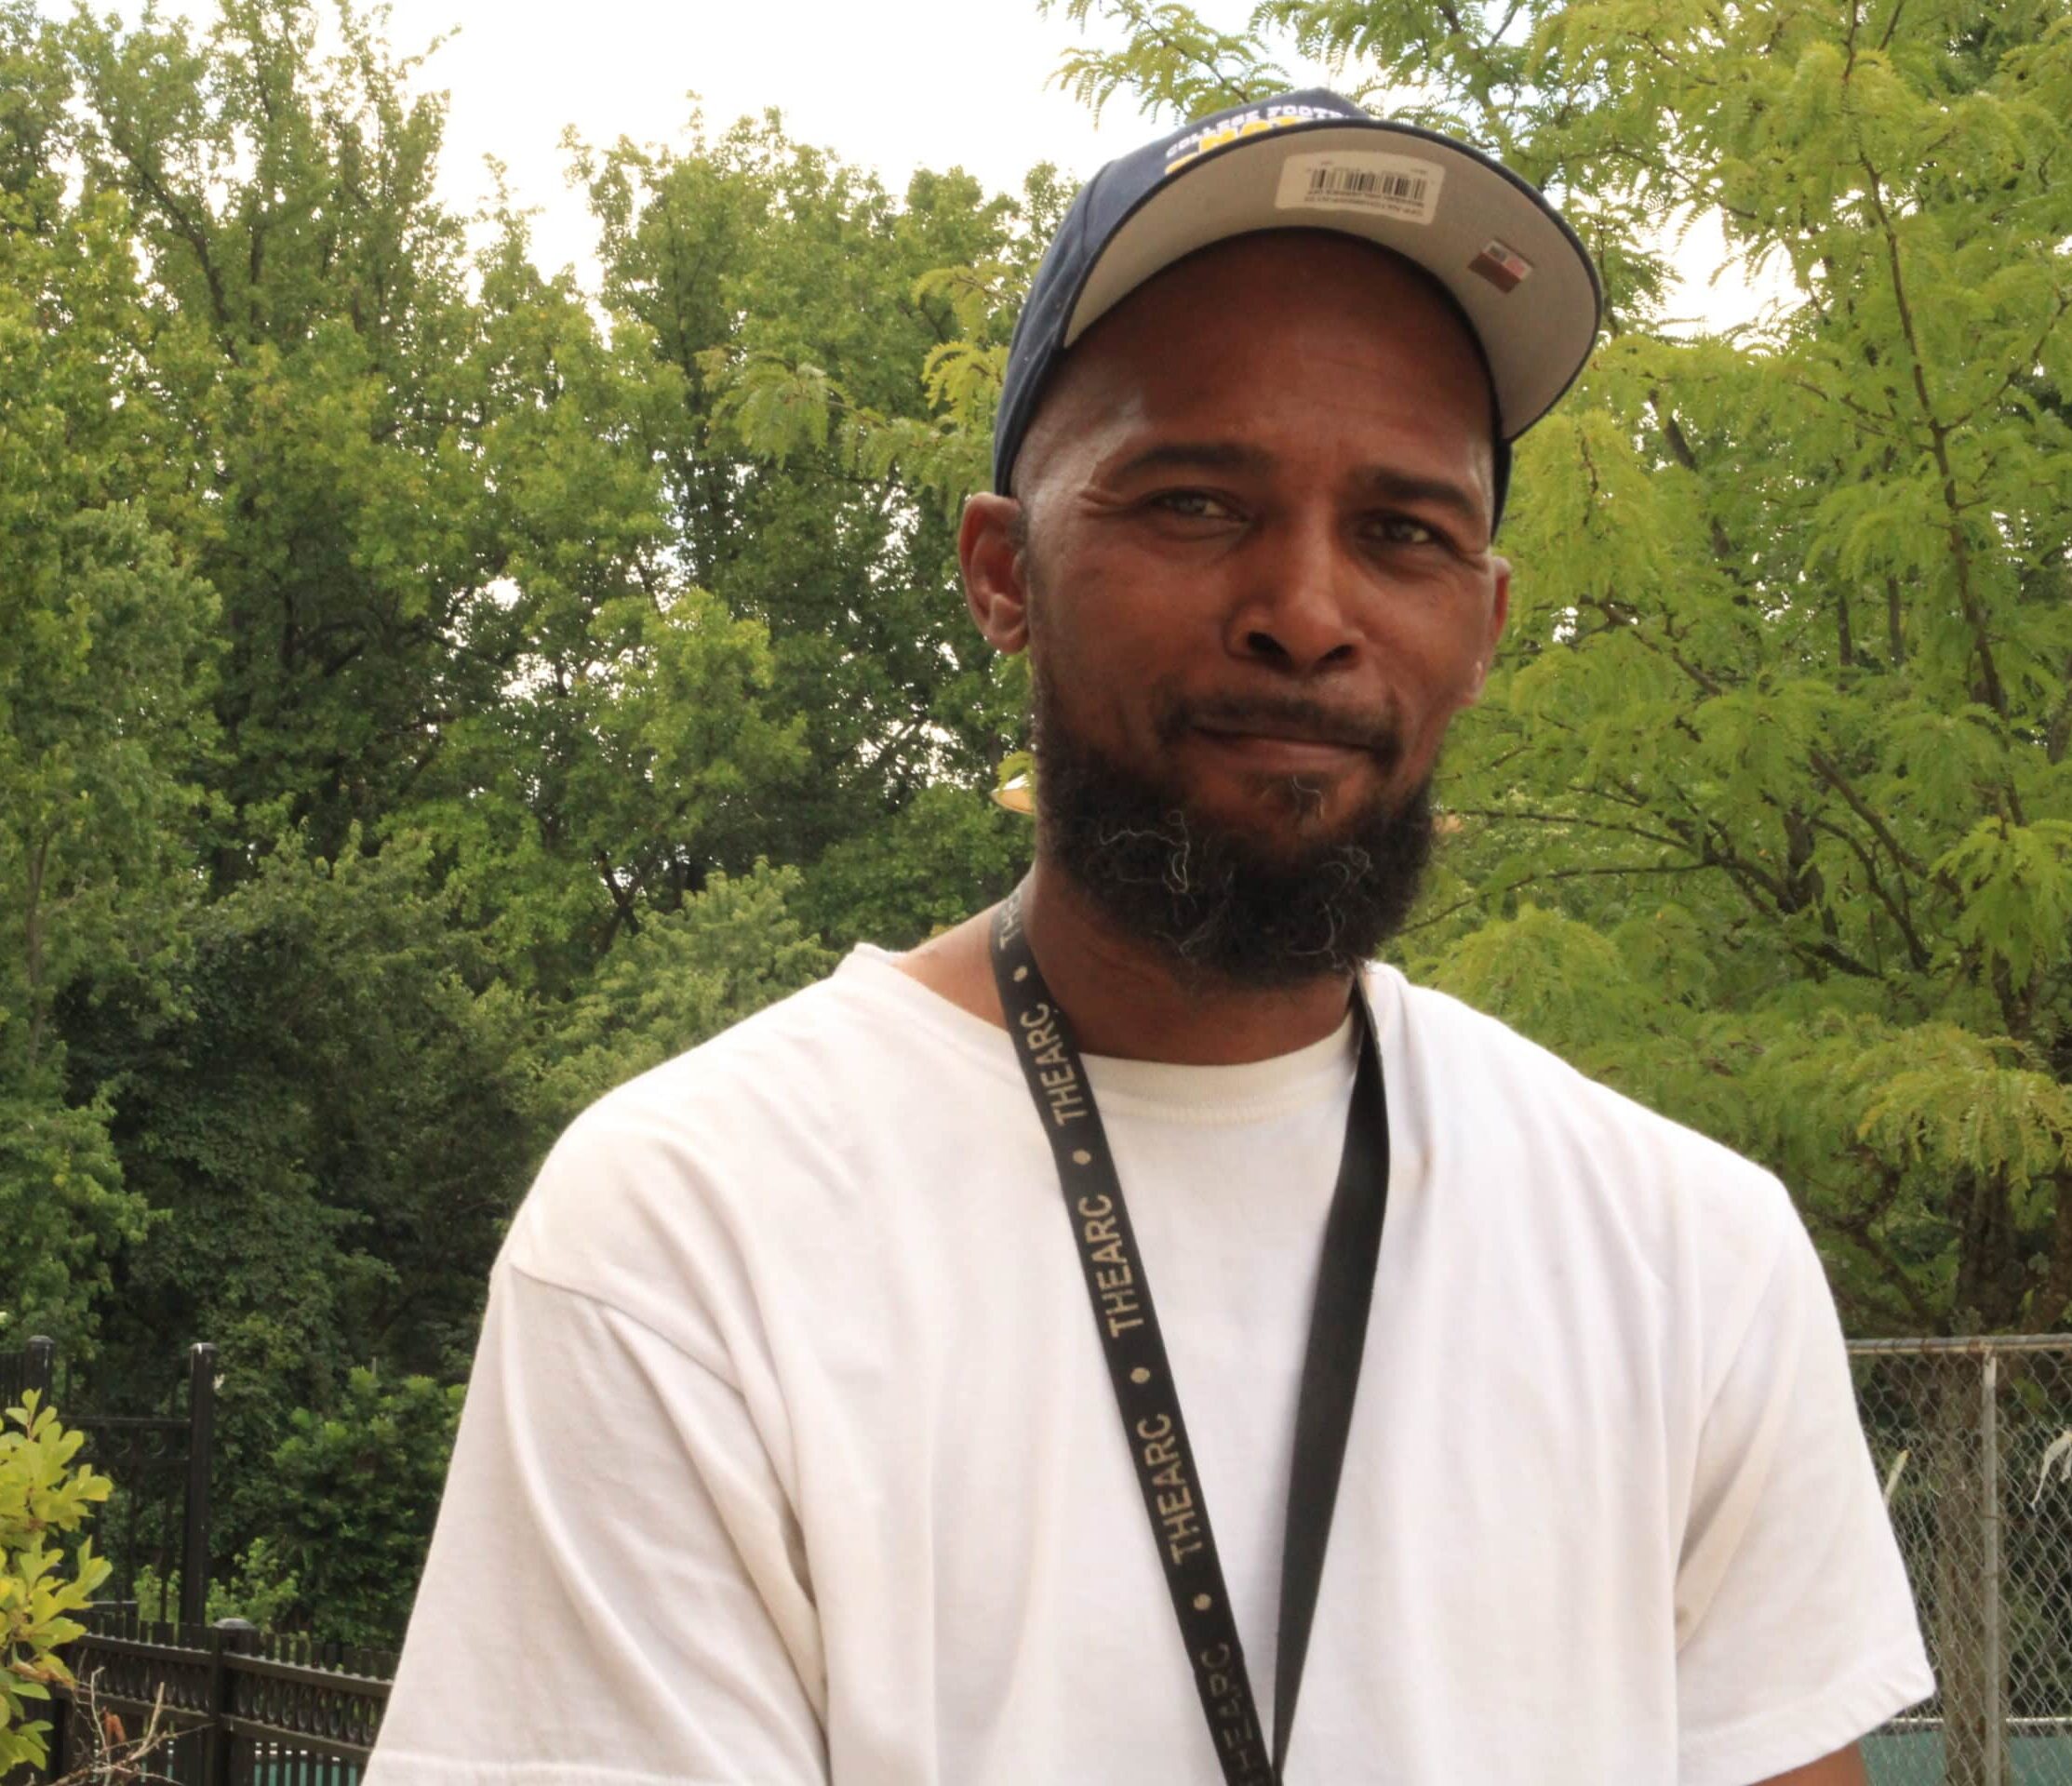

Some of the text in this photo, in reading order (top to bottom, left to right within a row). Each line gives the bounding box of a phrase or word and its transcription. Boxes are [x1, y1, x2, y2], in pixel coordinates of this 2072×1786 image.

[1020, 1003, 1088, 1126] THEARC
[1077, 1193, 1144, 1339] THEARC
[1136, 1413, 1203, 1566] THEARC
